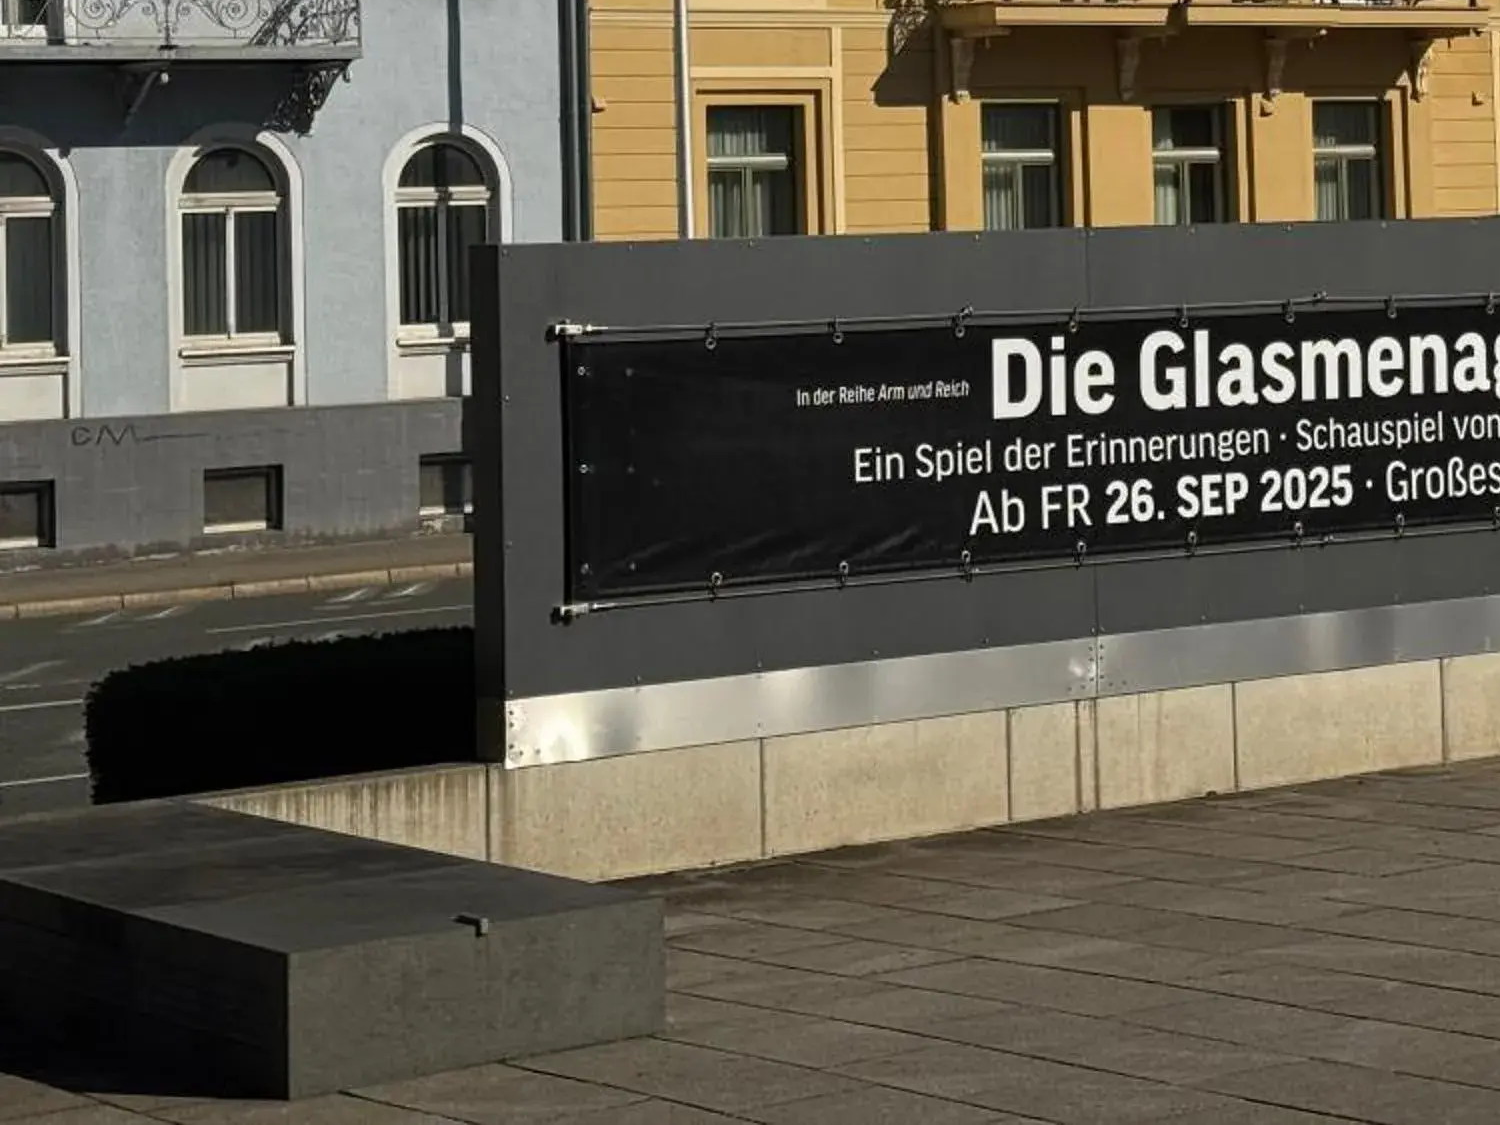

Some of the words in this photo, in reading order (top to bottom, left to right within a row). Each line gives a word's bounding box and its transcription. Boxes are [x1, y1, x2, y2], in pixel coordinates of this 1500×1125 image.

[797, 389, 810, 406] In
[813, 387, 836, 406] der
[839, 385, 875, 404] Reihe
[878, 384, 905, 401] Arm
[908, 381, 932, 399] und
[935, 380, 970, 397] Reich
[992, 336, 1115, 419] Die
[855, 447, 904, 482] Ein
[915, 440, 992, 481] Spiel
[1005, 437, 1056, 471] der
[1067, 429, 1270, 467] Erinnerungen
[1296, 411, 1444, 451] Schauspiel
[970, 489, 1024, 535] Ab
[1041, 484, 1092, 529] FR
[1105, 479, 1165, 524] 26.
[1176, 472, 1249, 518] SEP
[1260, 465, 1353, 512] 2025
